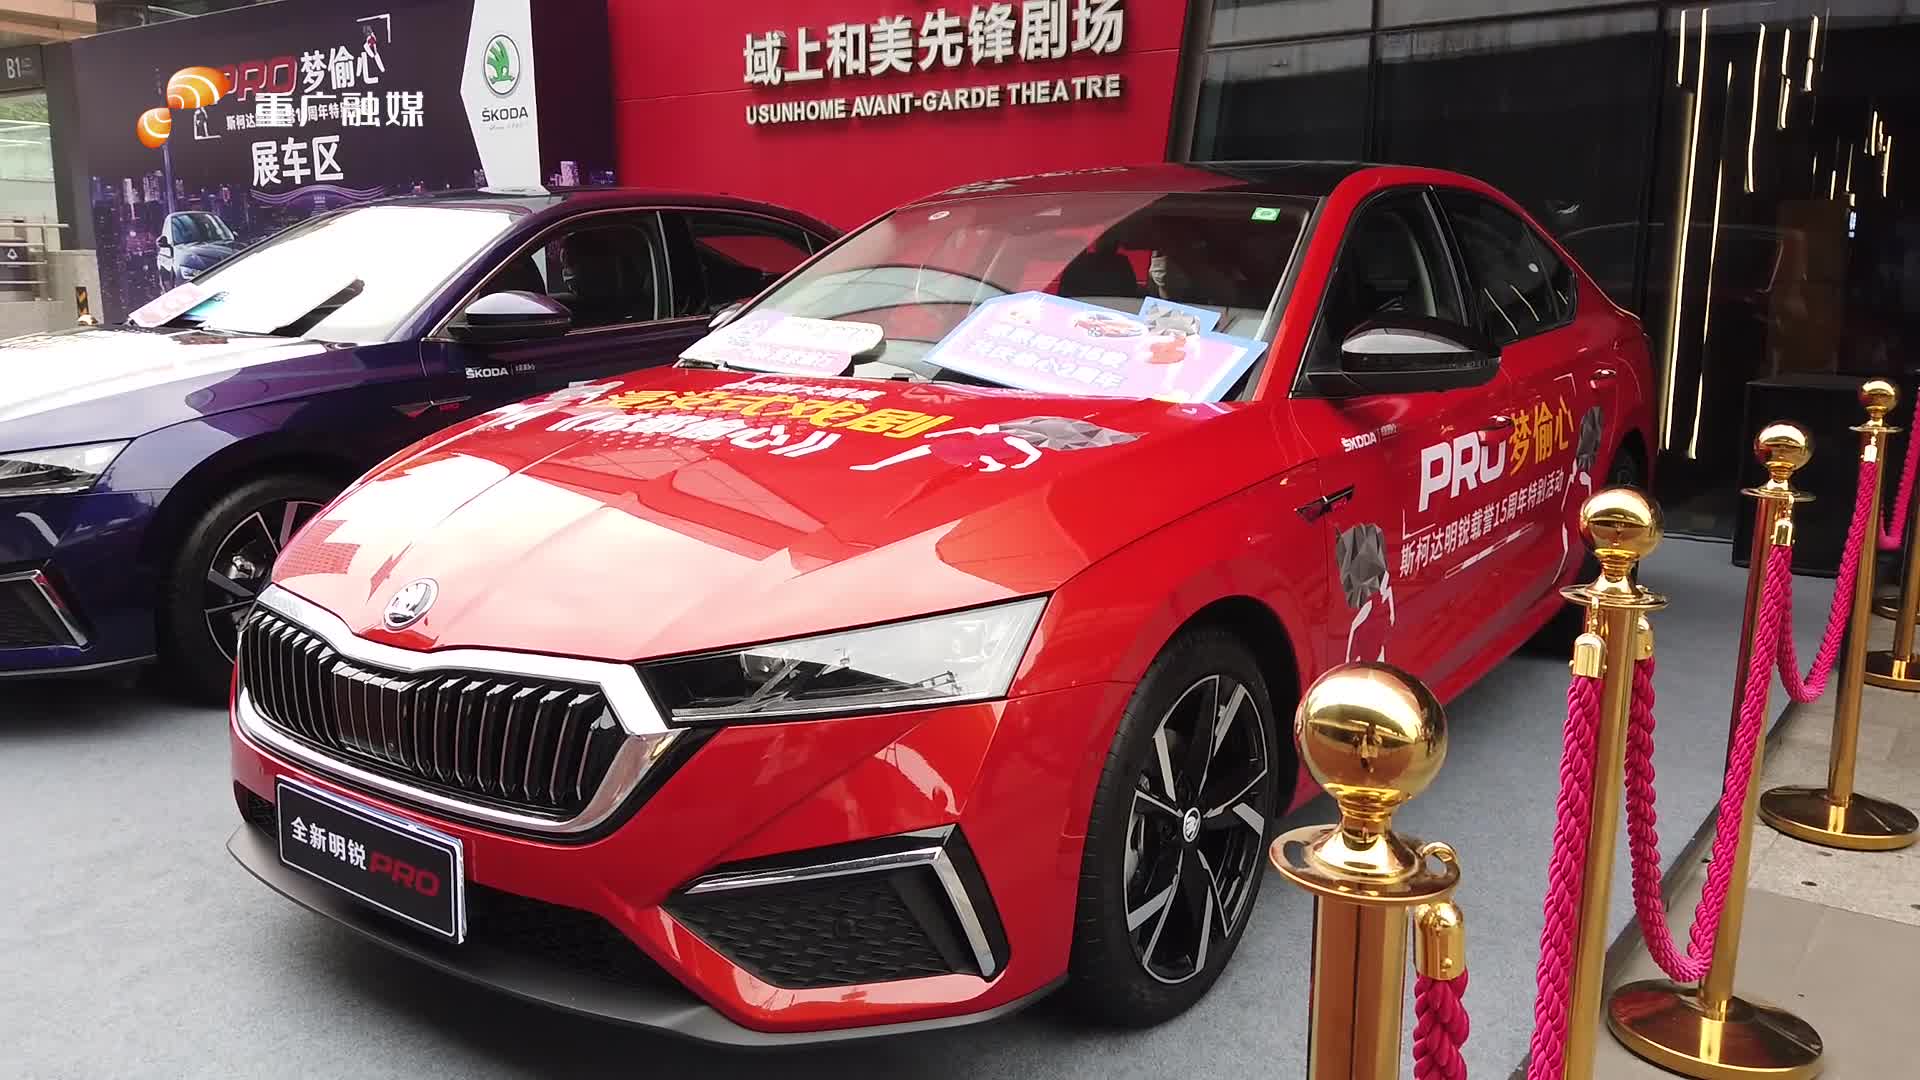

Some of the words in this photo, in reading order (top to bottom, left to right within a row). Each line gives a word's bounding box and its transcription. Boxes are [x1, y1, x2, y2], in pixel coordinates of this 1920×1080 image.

[6, 57, 21, 79] B1
[743, 0, 1124, 86] 域上和美先锋剧场
[481, 106, 529, 122] ŠKODA
[746, 99, 846, 125] USUNHOME
[851, 84, 1000, 117] AVANT-GARDE
[1006, 73, 1121, 105] THEATRE
[251, 135, 344, 187] 展车区
[1400, 469, 1565, 578] 斯柯达明锐载誉15周年特别活动
